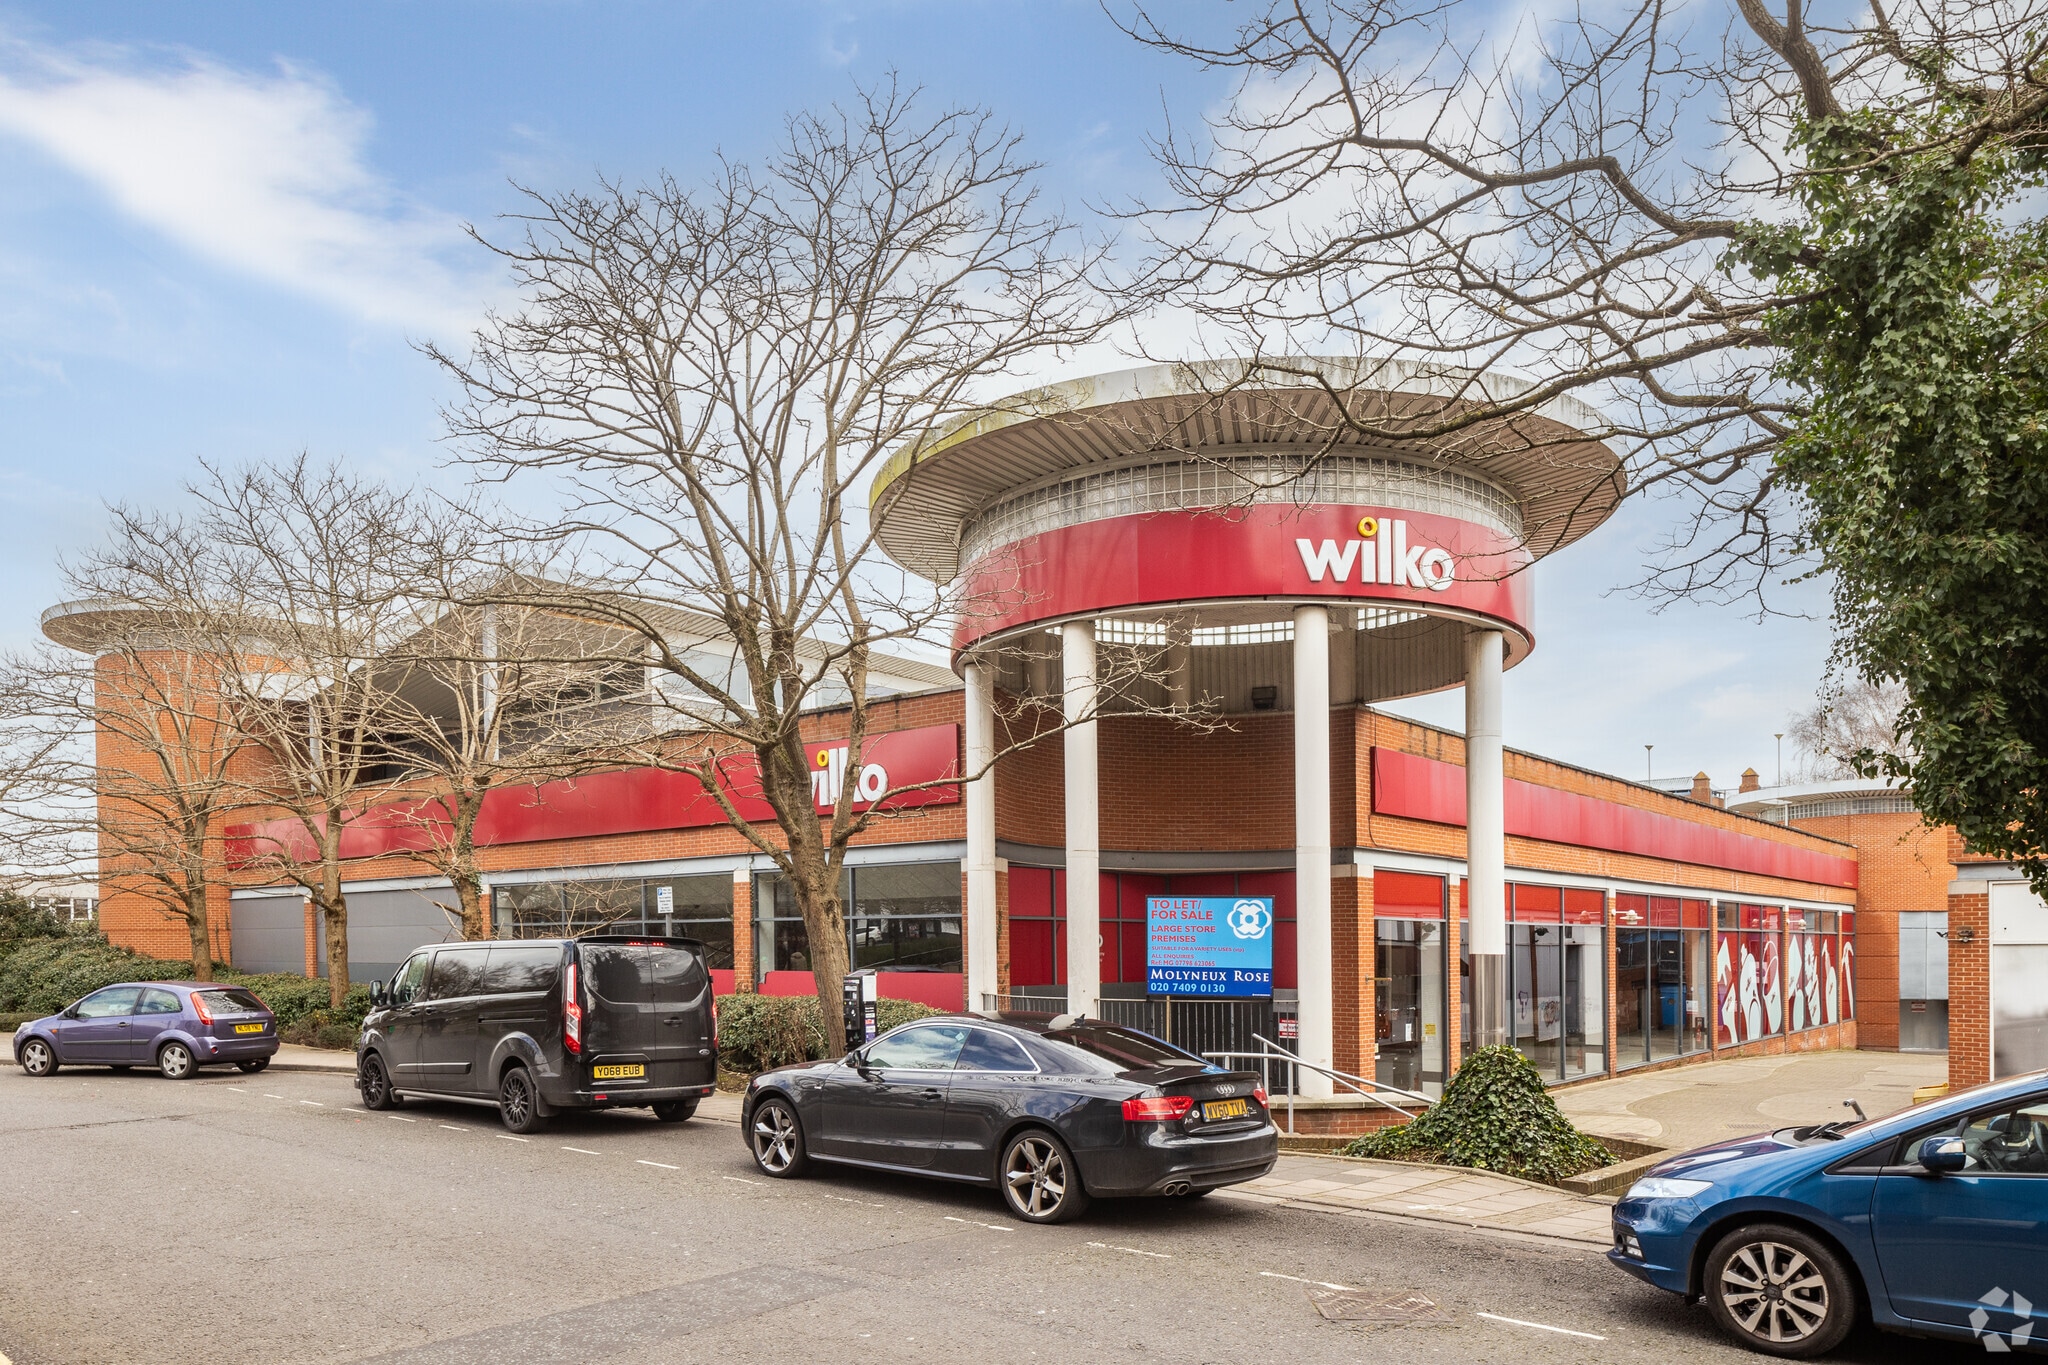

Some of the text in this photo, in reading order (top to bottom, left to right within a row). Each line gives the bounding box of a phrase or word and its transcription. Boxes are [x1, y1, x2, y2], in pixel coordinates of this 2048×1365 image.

[1295, 516, 1455, 591] wilko
[811, 747, 888, 806] ilko
[1151, 899, 1202, 910] TO LET/
[1151, 910, 1213, 920] FOR SALE
[1151, 925, 1216, 933] LARGE STORE
[1151, 935, 1196, 943] PREMISES
[1150, 982, 1225, 993] 020 7409 0130
[597, 1065, 640, 1077] YO68 EUB
[1230, 1100, 1247, 1116] TVA
